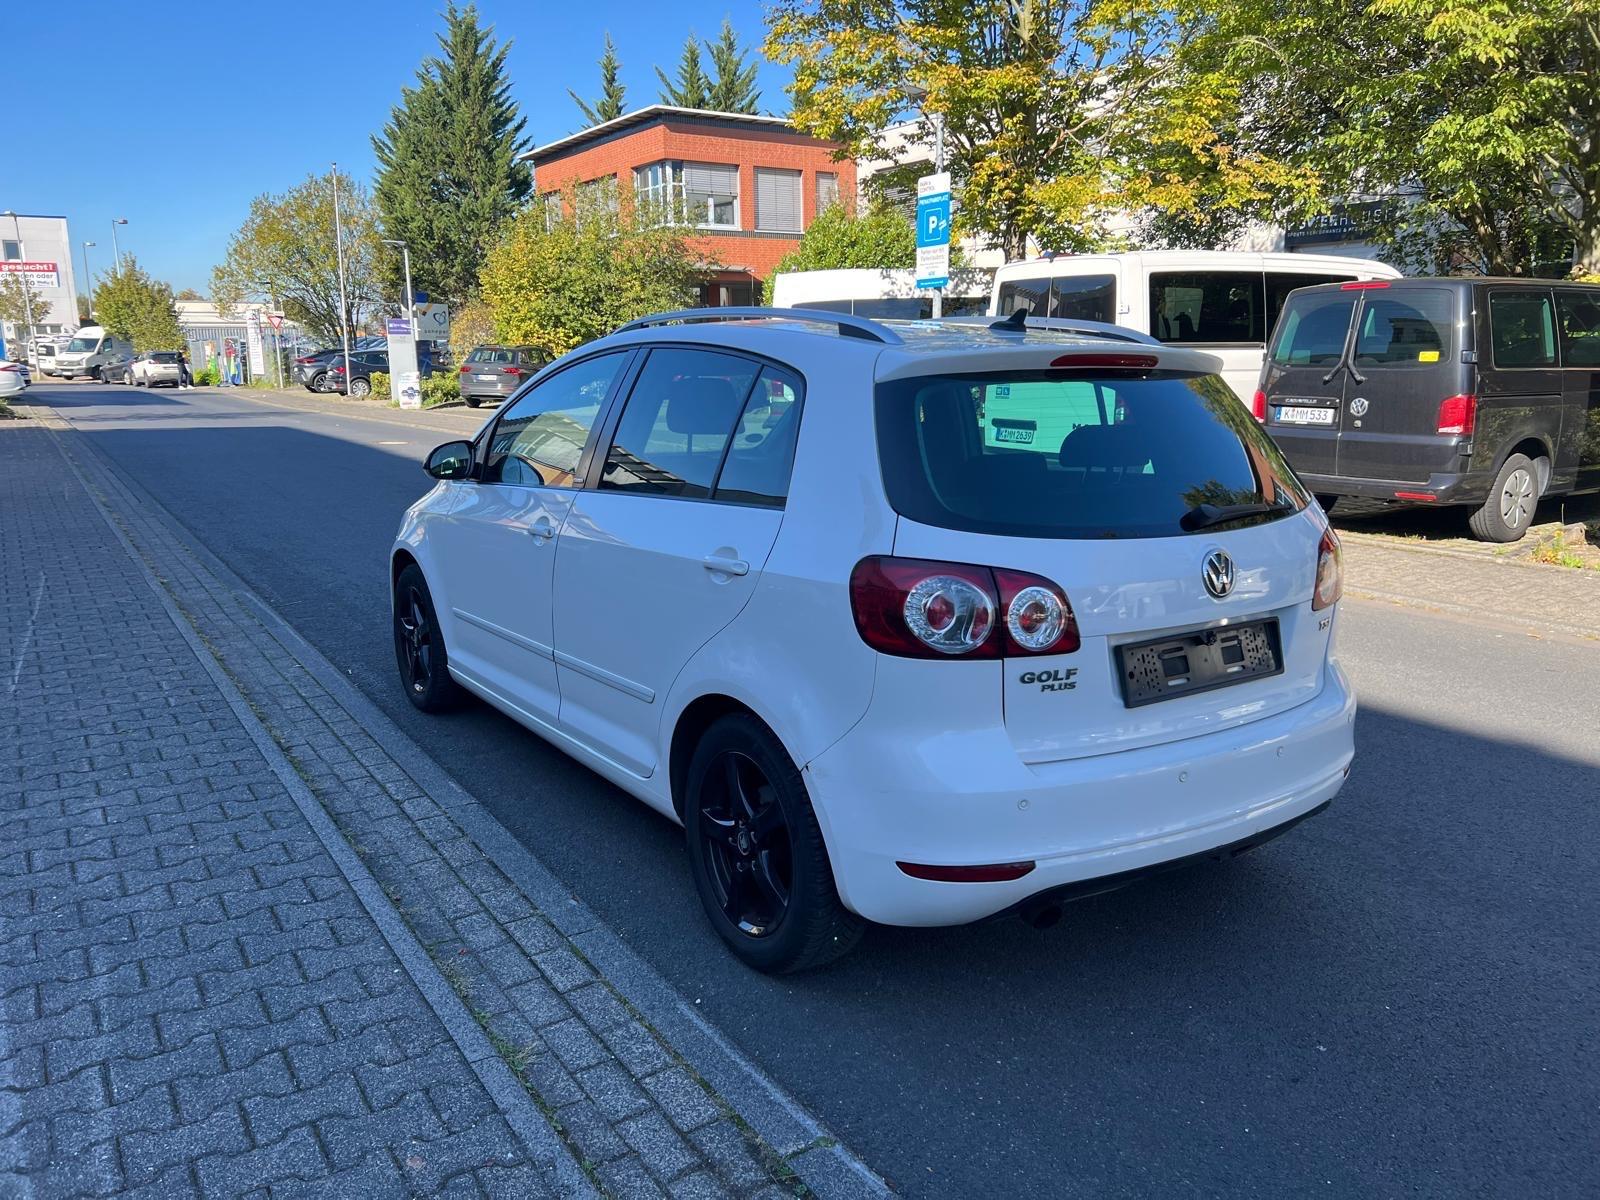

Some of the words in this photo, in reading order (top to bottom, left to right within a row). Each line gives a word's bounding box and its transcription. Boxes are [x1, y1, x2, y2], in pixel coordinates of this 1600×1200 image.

[929, 215, 938, 234] P
[1202, 549, 1234, 598] VW
[1019, 668, 1078, 684] GOLF
[1040, 682, 1077, 692] PLUS
